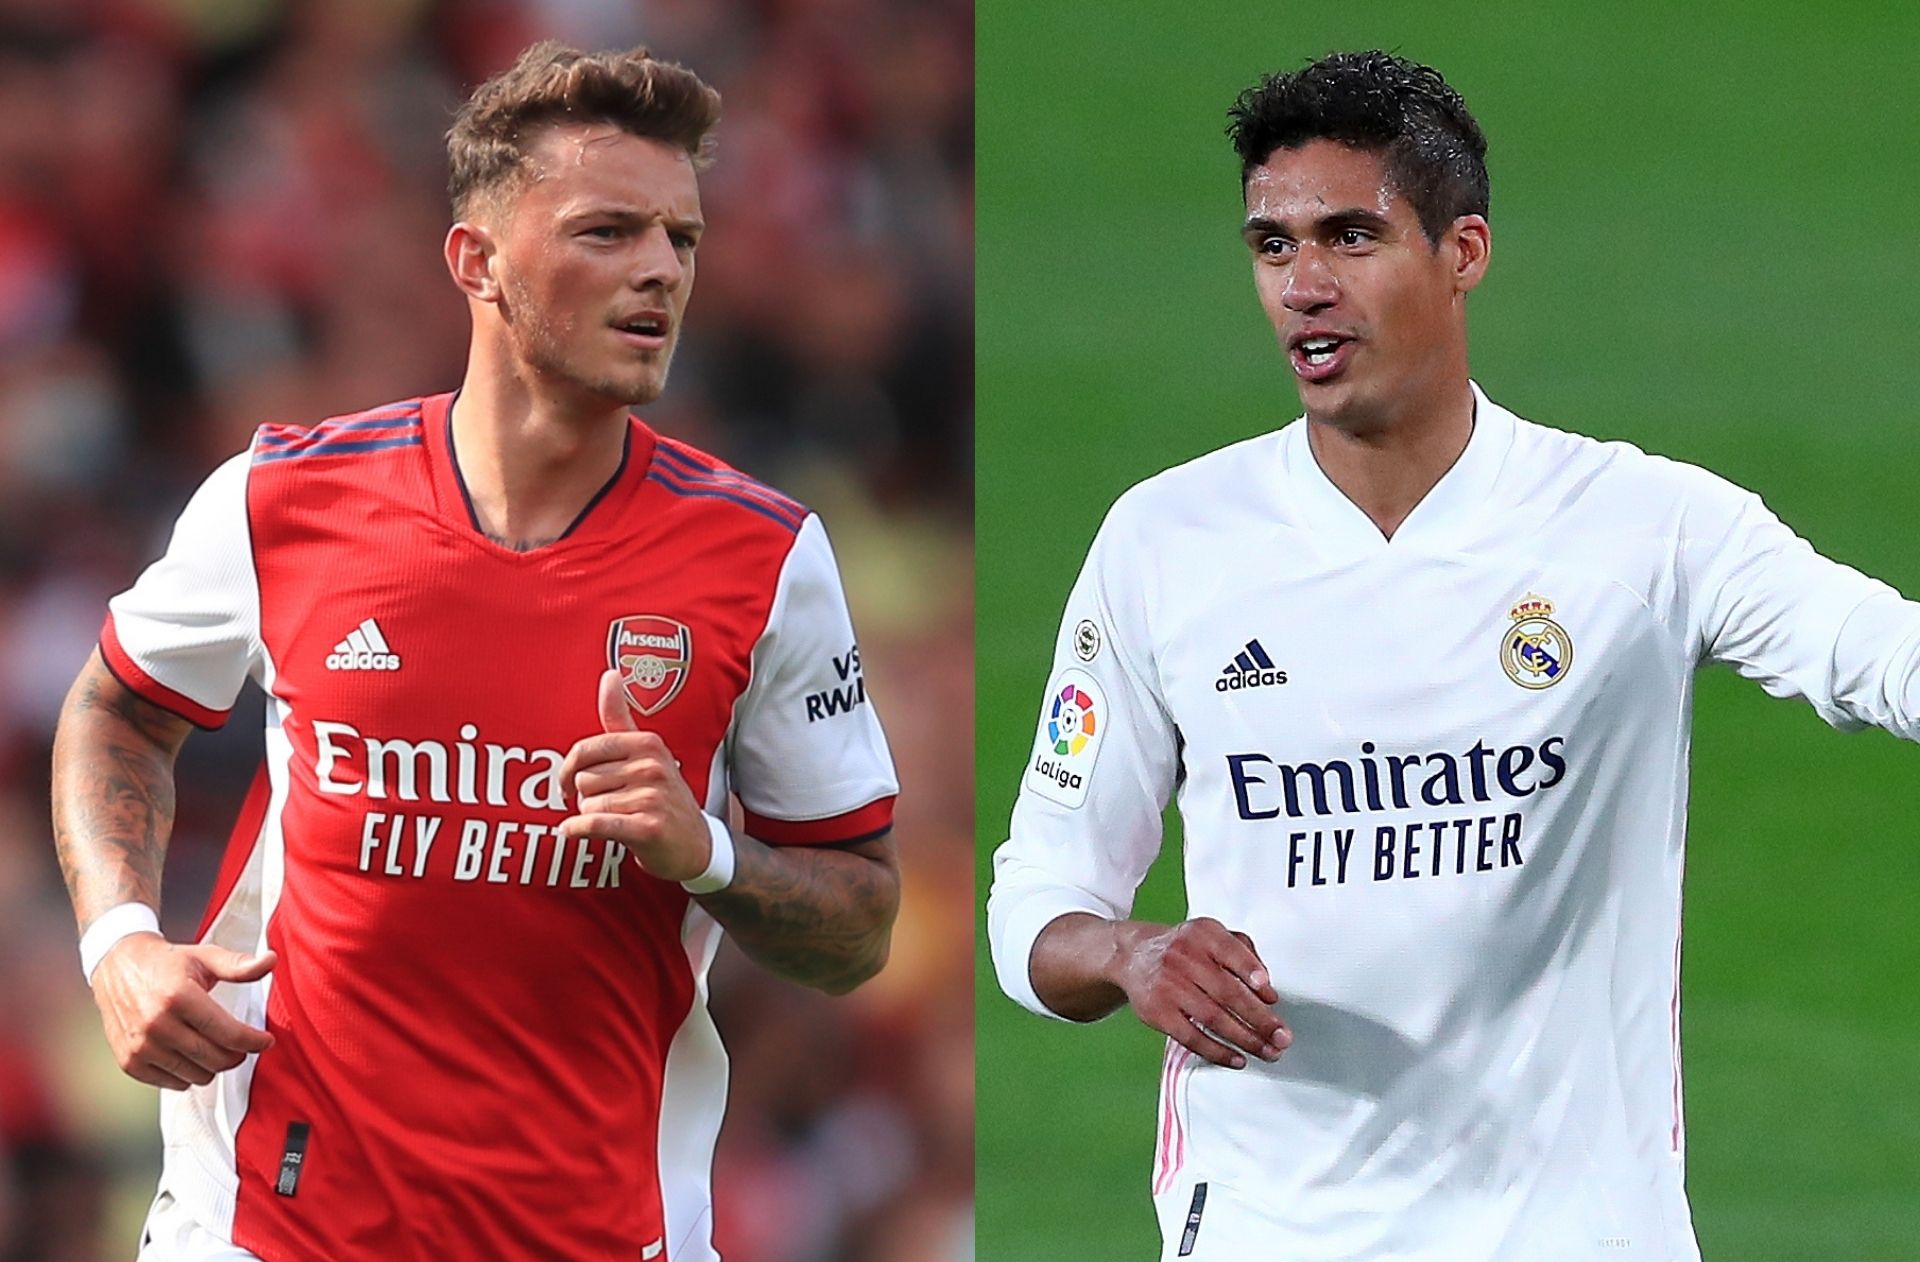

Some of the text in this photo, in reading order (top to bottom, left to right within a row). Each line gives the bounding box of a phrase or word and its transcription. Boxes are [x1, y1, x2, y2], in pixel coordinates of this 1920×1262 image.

[325, 651, 400, 670] adidas
[620, 630, 681, 650] Arsenal
[1215, 667, 1288, 692] adidas
[312, 719, 567, 811] Emira
[1034, 754, 1083, 790] LaLiga
[1225, 736, 1567, 820] Emirates
[359, 812, 626, 888] FLY BETTER
[1287, 812, 1523, 888] FLY BETTER
